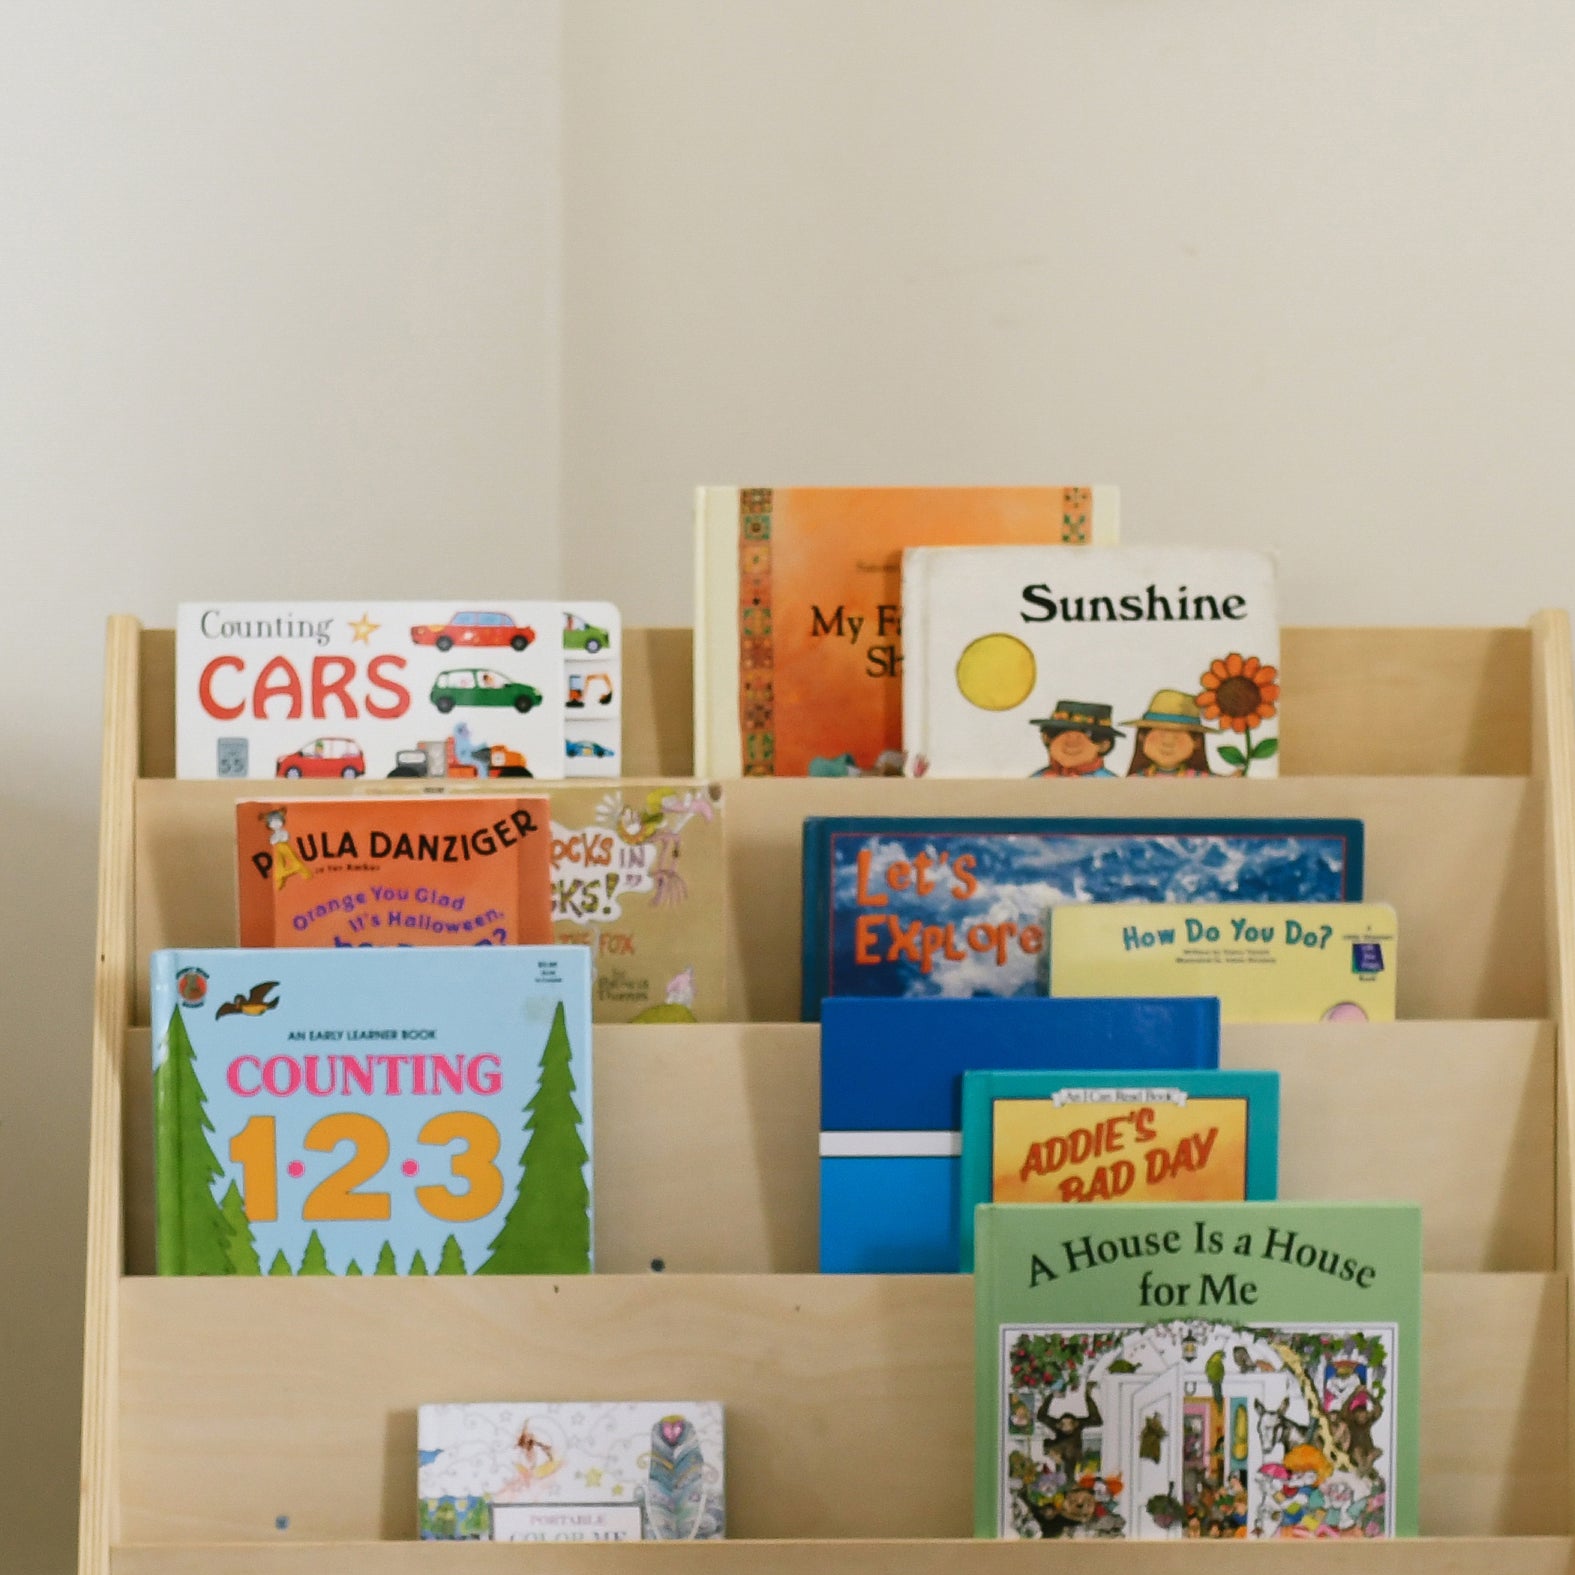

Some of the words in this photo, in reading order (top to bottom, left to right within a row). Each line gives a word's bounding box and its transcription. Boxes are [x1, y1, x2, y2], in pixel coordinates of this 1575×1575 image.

[1021, 583, 1247, 623] Sunshine
[200, 609, 334, 646] Counting
[811, 604, 864, 645] My
[198, 655, 411, 720] CARS
[251, 831, 358, 891] PAULA
[370, 809, 538, 862] DANZIGER
[620, 844, 645, 868] IN
[856, 849, 978, 907] Let's
[292, 892, 366, 931] Orange
[372, 886, 409, 901] You
[415, 887, 465, 911] Glad
[1123, 926, 1175, 951] How
[1185, 918, 1220, 943] Do
[1231, 918, 1274, 942] You
[1285, 919, 1333, 949] Do?
[288, 1031, 306, 1041] AN
[309, 1030, 343, 1041] EARLY
[347, 1030, 397, 1041] LEARNER
[401, 1029, 437, 1040] BOOK
[226, 1053, 503, 1097] COUNTING
[1019, 1107, 1157, 1183] ADDIE'S
[1058, 1160, 1136, 1203] BAD
[1145, 1127, 1219, 1185] DAY
[1026, 1253, 1057, 1288] A
[1061, 1224, 1181, 1273] House
[1194, 1221, 1224, 1255] Is
[1233, 1231, 1252, 1257] a
[1261, 1227, 1376, 1289] House
[1138, 1270, 1191, 1307] for
[1199, 1273, 1259, 1306] Me
[529, 1513, 605, 1526] PORTABLE
